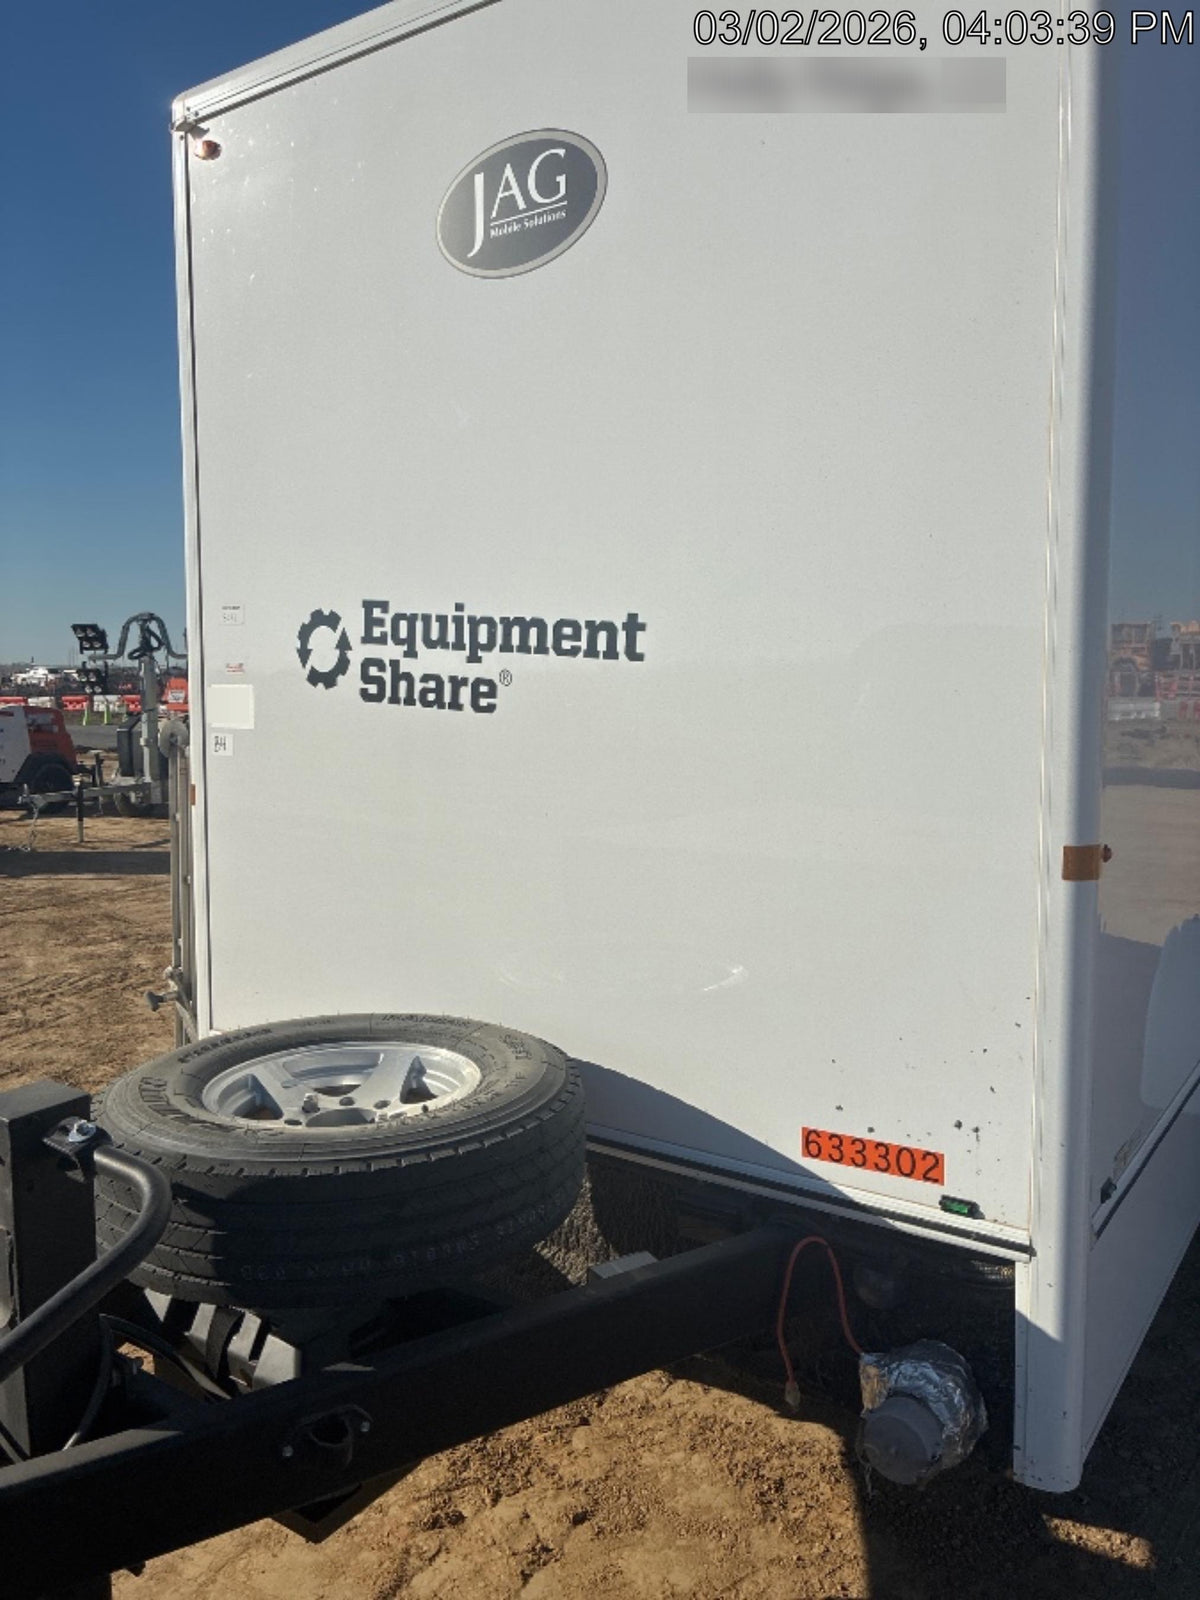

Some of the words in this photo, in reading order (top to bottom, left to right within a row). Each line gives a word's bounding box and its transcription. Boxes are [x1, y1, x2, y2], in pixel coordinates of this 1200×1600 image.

[467, 149, 566, 258] JAG
[523, 210, 566, 229] Solutions
[360, 599, 648, 664] Equipment
[804, 1129, 940, 1184] 633302
